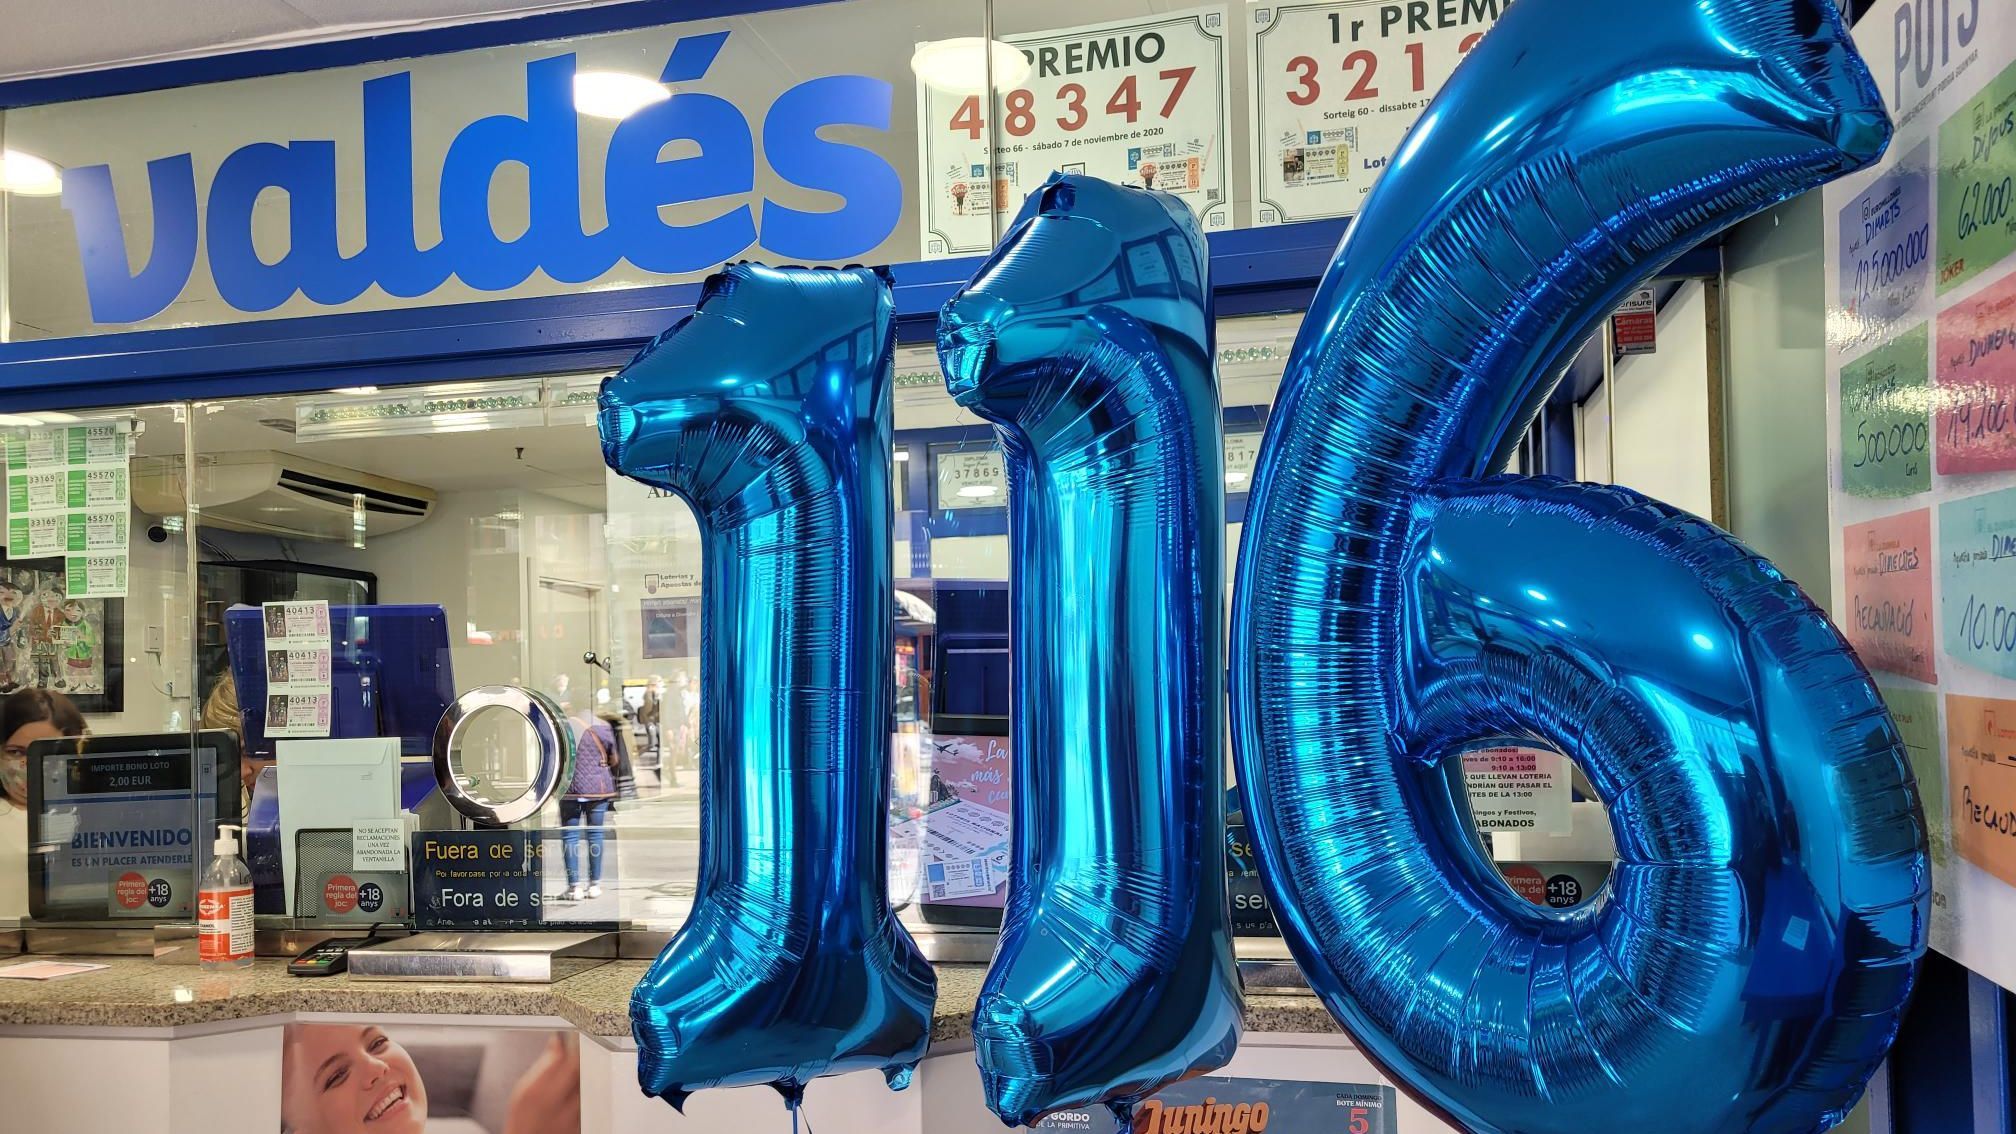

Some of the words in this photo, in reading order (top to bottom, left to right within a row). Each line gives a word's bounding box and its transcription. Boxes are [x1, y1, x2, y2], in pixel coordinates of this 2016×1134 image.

[1380, 0, 1513, 38] PREM
[1021, 32, 1166, 78] REMIO
[1323, 109, 1356, 120] Sorteig
[1357, 107, 1369, 116] 60
[1379, 101, 1417, 113] dissabte
[1013, 144, 1023, 152] 66
[1032, 140, 1063, 152] sábado
[1064, 140, 1070, 149] 7
[1071, 138, 1082, 147] de
[1083, 132, 1129, 145] noviembre
[1130, 130, 1141, 139] de
[1143, 127, 1164, 137] 2020
[62, 31, 903, 324] valdés
[88, 471, 115, 480] 45570
[88, 514, 115, 522] 45570
[88, 558, 115, 566] 45570
[286, 606, 315, 615] 40413
[289, 651, 317, 660] 40413
[289, 695, 318, 704] 40413
[91, 763, 124, 772] IMPORTE
[125, 762, 149, 771] BONO
[150, 761, 170, 769] LOTO
[132, 775, 151, 785] EUR
[71, 828, 192, 849] BIENVENIDO
[425, 841, 479, 860] Fuera
[489, 841, 513, 859] de
[71, 858, 82, 867] ES
[102, 855, 137, 866] PLACER
[140, 854, 192, 865] ATENDERLE
[118, 880, 146, 888] Primera
[327, 883, 356, 892] Primera
[1547, 881, 1577, 896] +18
[117, 888, 135, 896] regla
[149, 884, 169, 896] +18
[360, 888, 380, 900] +18
[1528, 885, 1545, 894] del
[326, 891, 344, 900] regla
[345, 891, 357, 899] del
[441, 888, 484, 907] Fora
[495, 888, 519, 907] de
[1550, 896, 1575, 904] anys
[1336, 1099, 1354, 1107] BOTE
[1355, 1099, 1383, 1108] MÍNIMO
[1050, 1112, 1090, 1122] GORDO
[1349, 1109, 1370, 1134] 5
[1057, 1121, 1090, 1130] PRIMITIVA
